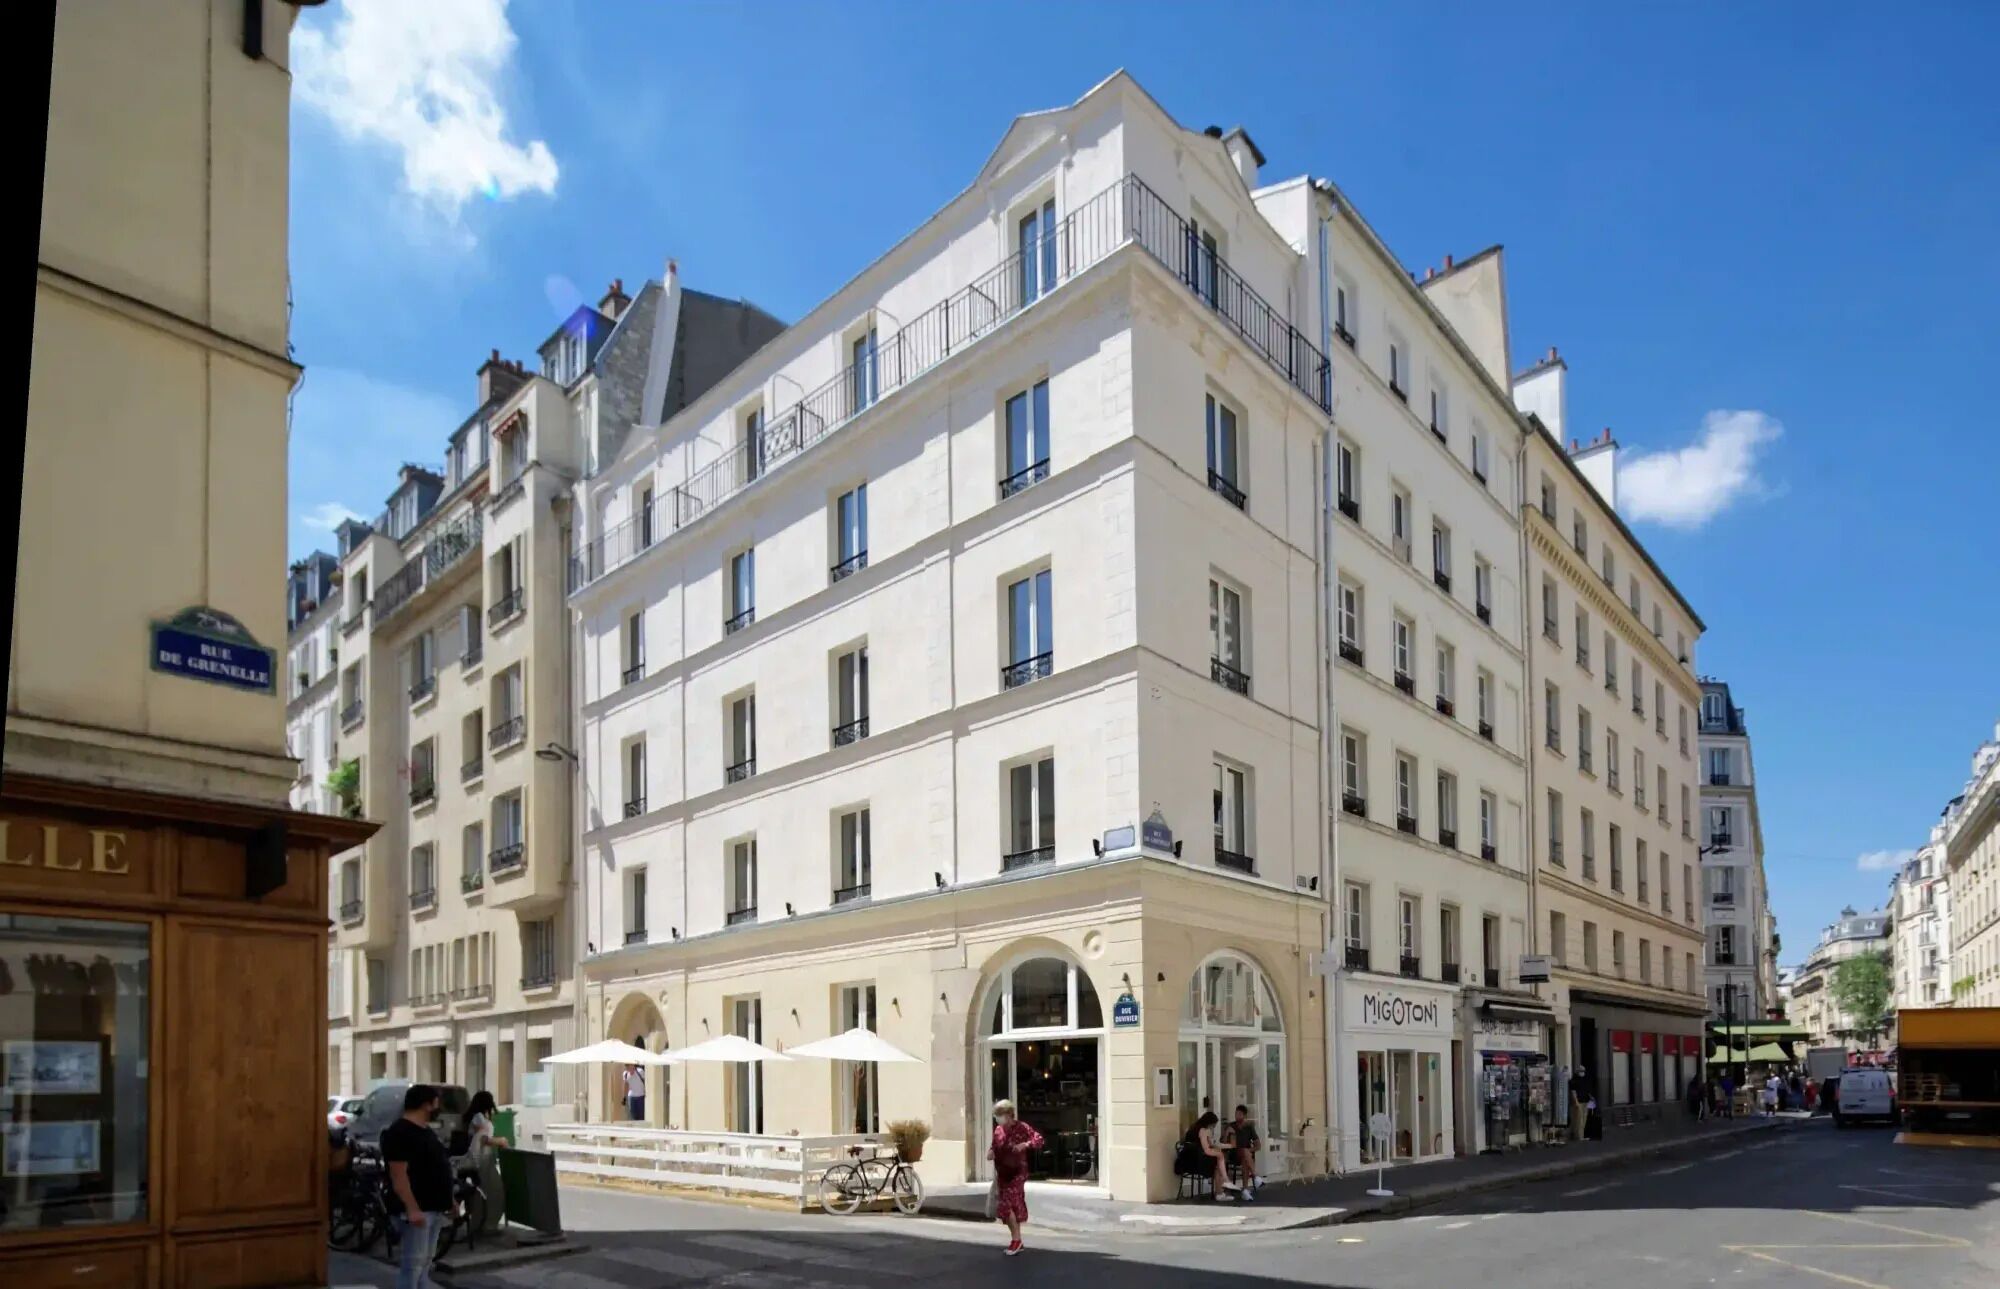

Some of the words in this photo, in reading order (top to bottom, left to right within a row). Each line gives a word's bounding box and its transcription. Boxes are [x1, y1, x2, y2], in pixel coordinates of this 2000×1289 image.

[201, 643, 232, 660] RUE
[160, 650, 182, 665] DE
[187, 656, 268, 684] GRENELLE
